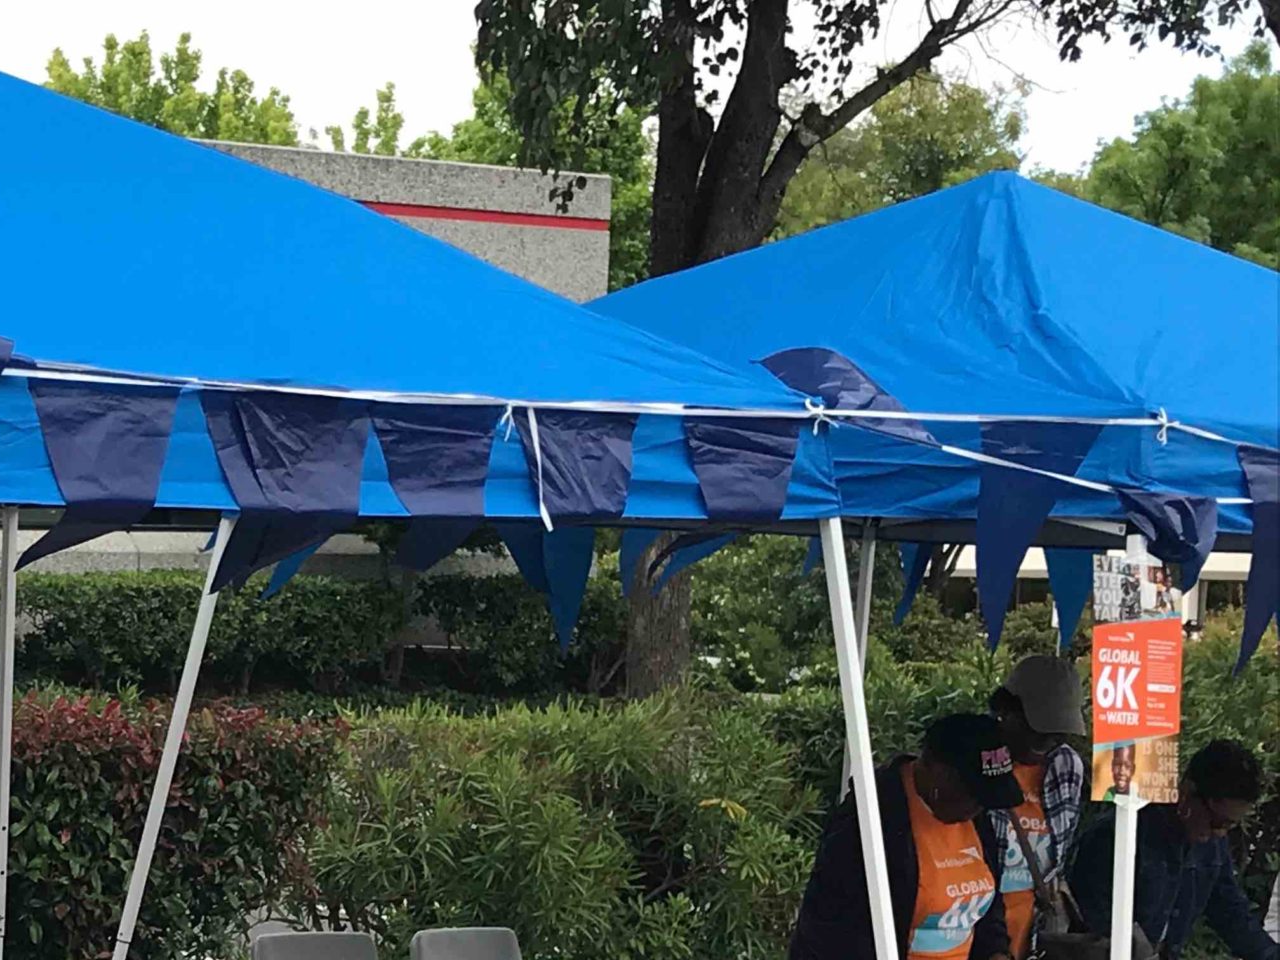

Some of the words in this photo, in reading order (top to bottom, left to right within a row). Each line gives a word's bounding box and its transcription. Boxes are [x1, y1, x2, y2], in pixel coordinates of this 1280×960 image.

[1099, 648, 1141, 665] GLOBAL
[1096, 665, 1140, 709] 6K
[1107, 711, 1139, 725] WATER
[1155, 740, 1179, 756] ONE
[946, 878, 995, 898] GLOBAL
